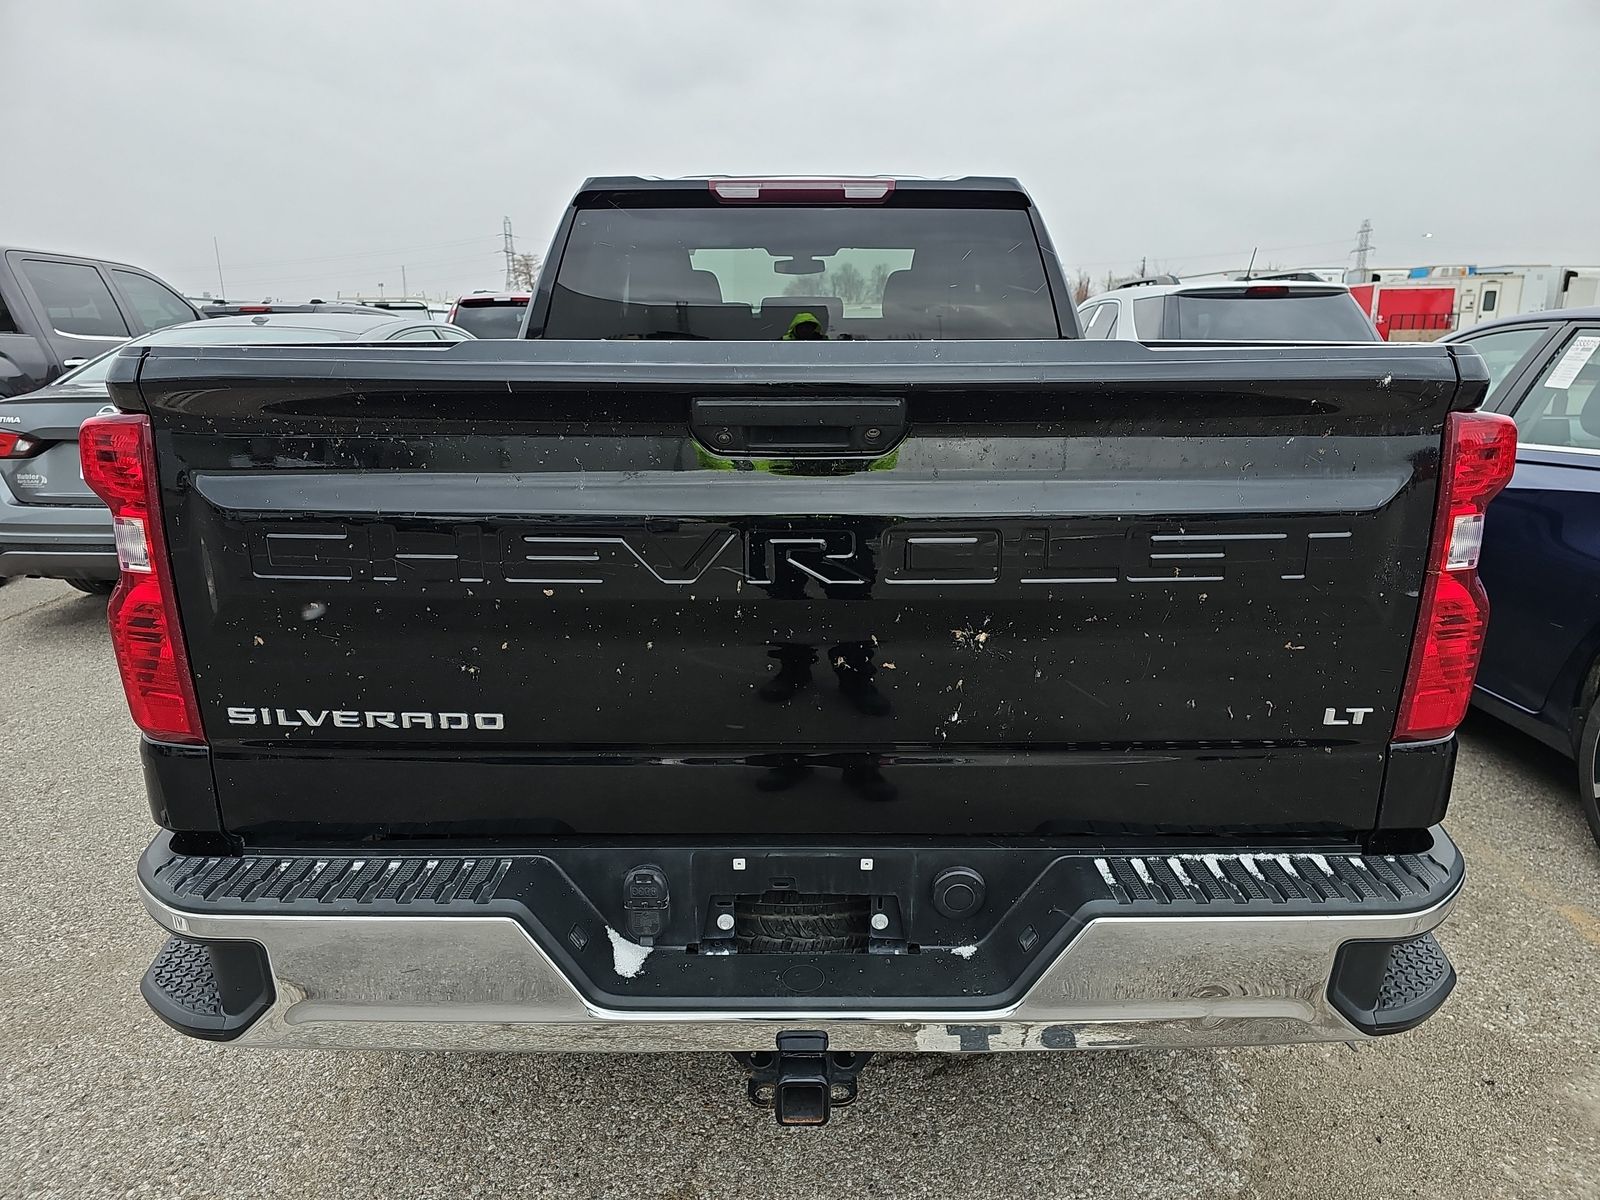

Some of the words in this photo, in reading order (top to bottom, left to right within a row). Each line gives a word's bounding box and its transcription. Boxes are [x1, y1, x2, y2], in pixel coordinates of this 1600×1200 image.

[249, 526, 1353, 586] CHEVROLET
[226, 706, 505, 730] SILVERADO
[1323, 707, 1374, 725] LT
